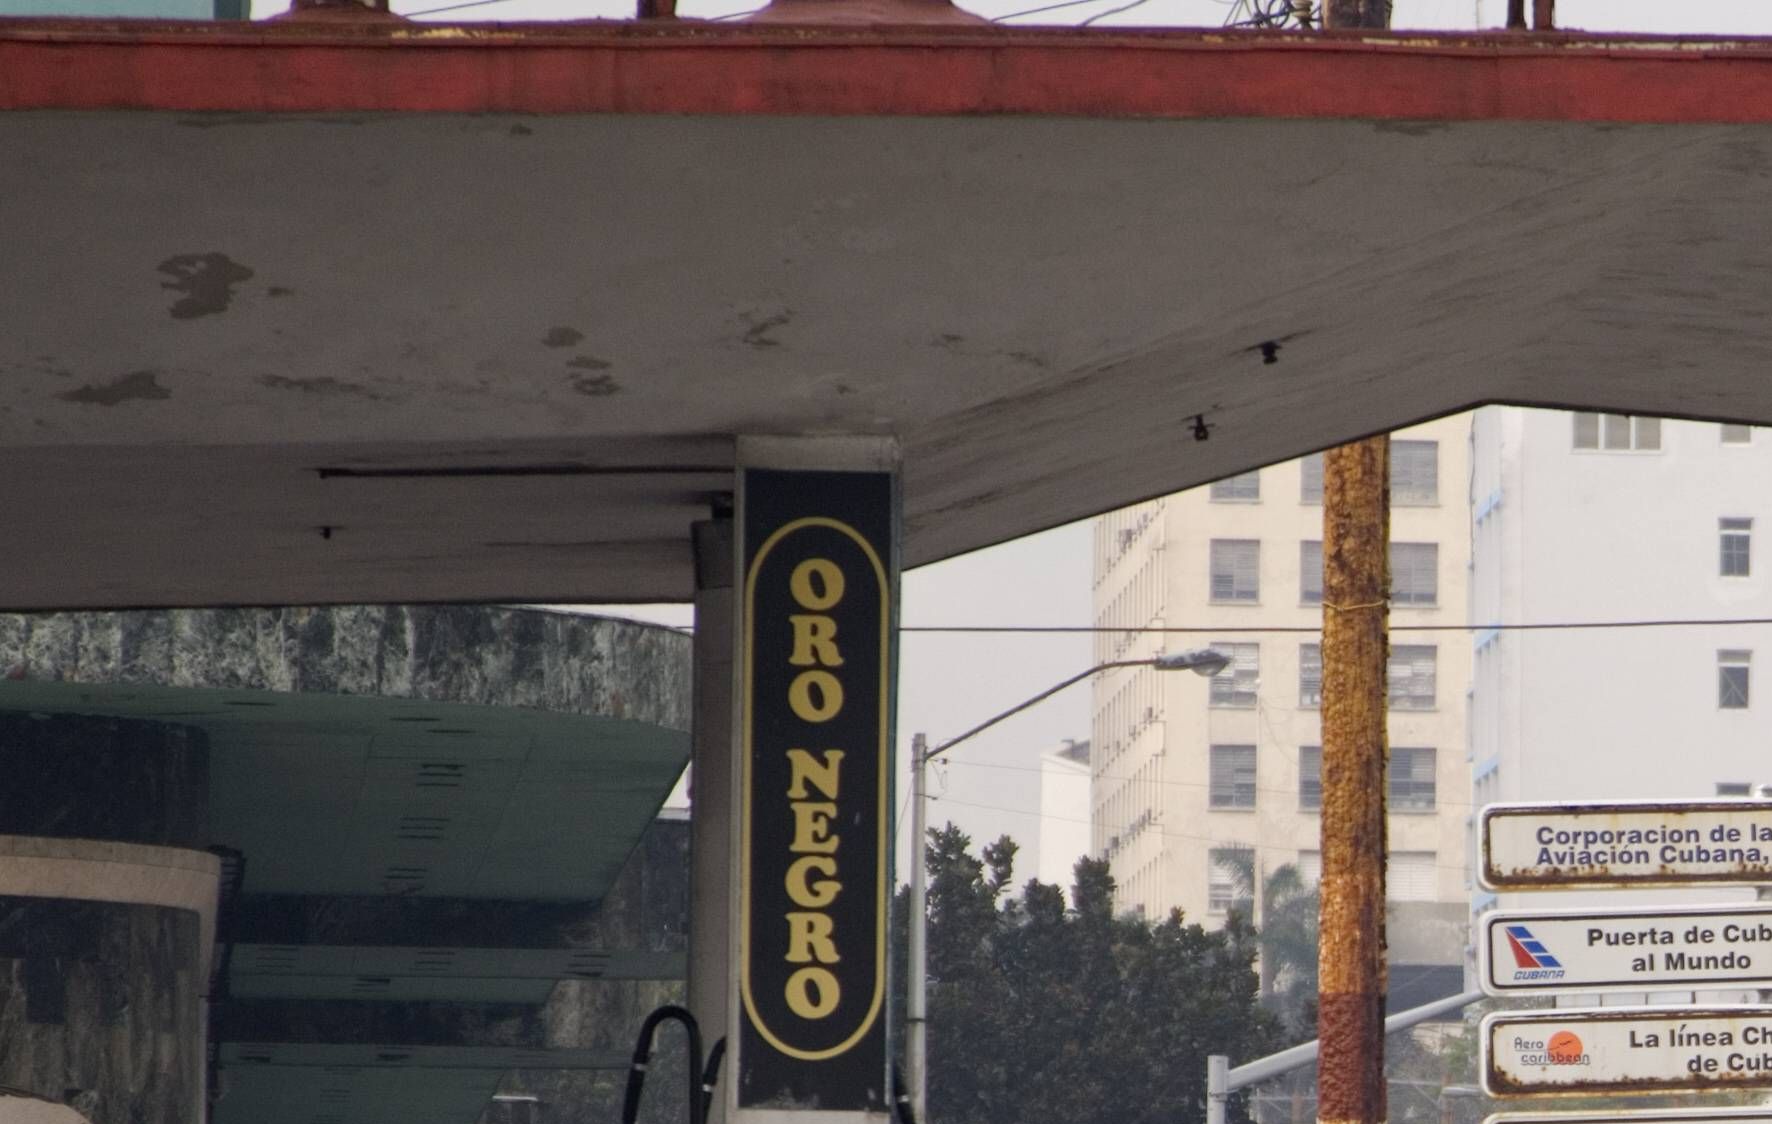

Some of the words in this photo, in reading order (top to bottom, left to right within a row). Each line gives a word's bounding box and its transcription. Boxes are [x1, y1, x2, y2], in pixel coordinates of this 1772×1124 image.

[788, 558, 846, 723] ORO
[1536, 824, 1700, 849] Corporacion
[1710, 824, 1741, 842] de
[1536, 845, 1650, 865] Aviación
[1659, 845, 1769, 865] Cubana,
[784, 749, 845, 1020] NEGRO
[1587, 928, 1674, 946] Puerta
[1684, 926, 1714, 943] de
[1631, 953, 1655, 972] al
[1665, 951, 1752, 971] Mundo
[1514, 1037, 1544, 1049] Aero
[1629, 1030, 1659, 1048] La
[1669, 1024, 1733, 1047] línea
[1521, 1053, 1591, 1065] caribbean
[1687, 1055, 1719, 1073] de
